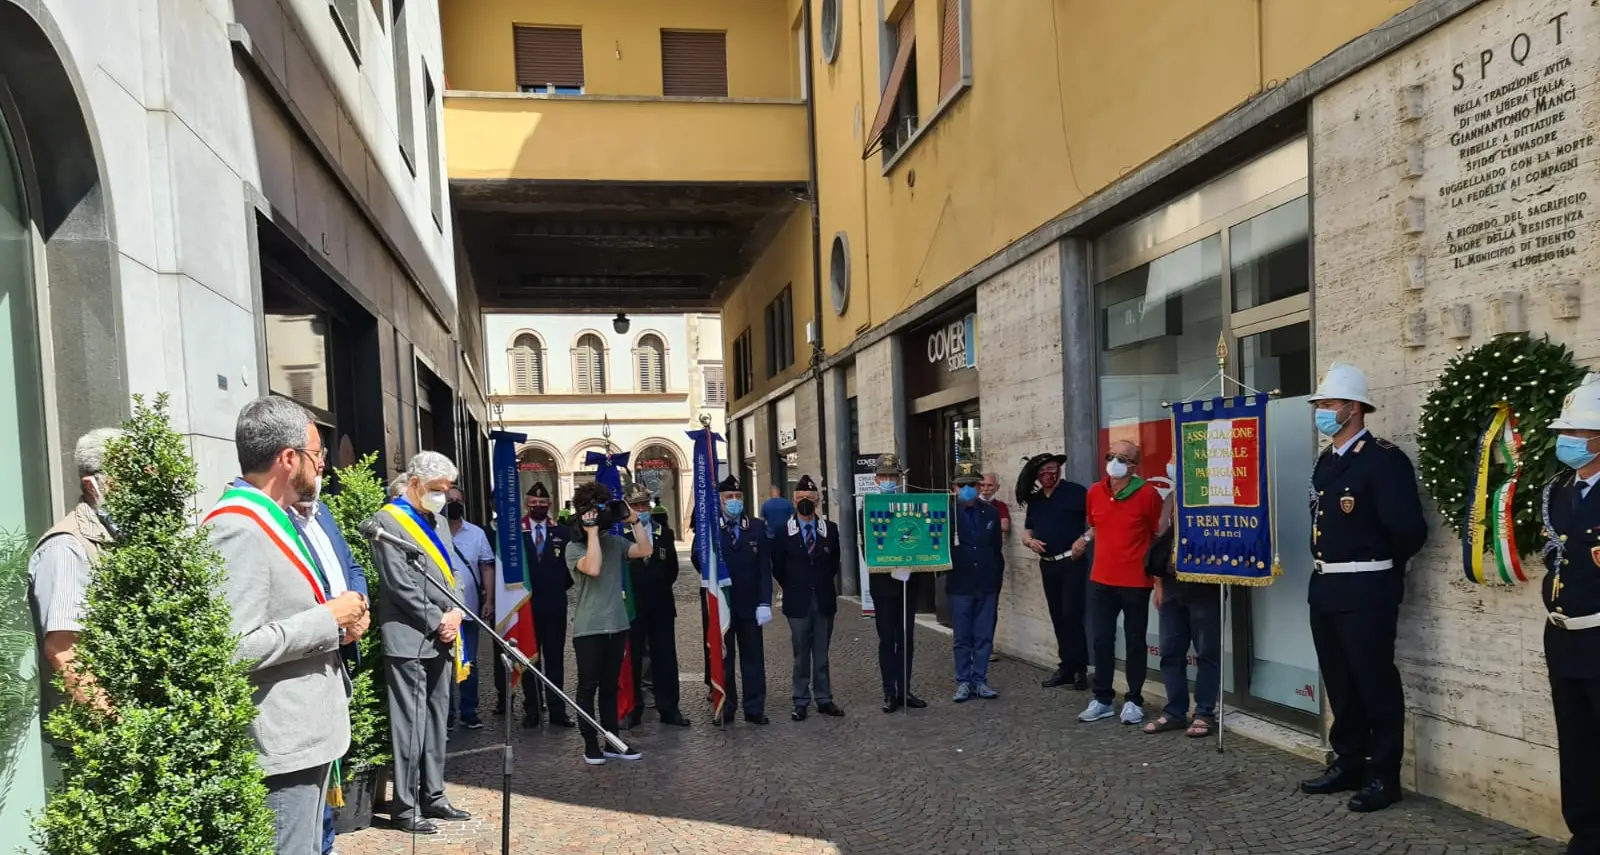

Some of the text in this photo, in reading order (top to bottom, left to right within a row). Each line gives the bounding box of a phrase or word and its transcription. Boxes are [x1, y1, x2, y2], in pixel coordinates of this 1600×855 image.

[1474, 109, 1492, 123] UNA
[1495, 93, 1529, 115] LIBERA
[1532, 77, 1565, 99] ITALIA
[1484, 72, 1539, 102] TRADIZIONE
[1459, 137, 1498, 160] RIBELLE
[1513, 110, 1566, 138] DITTATURE
[1439, 167, 1506, 197] SUGGELLANDO
[1511, 156, 1533, 172] CON
[1556, 135, 1593, 157] MORTE
[1525, 157, 1579, 183] COMPAGNI
[1457, 218, 1499, 238] RICORDO
[1504, 210, 1524, 224] DEL
[1528, 191, 1587, 217] SACRIFICIO
[1486, 229, 1516, 245] DELLA
[1521, 209, 1584, 236] RESISTENZA
[927, 320, 966, 363] COVER
[1185, 515, 1258, 529] TRENTINO
